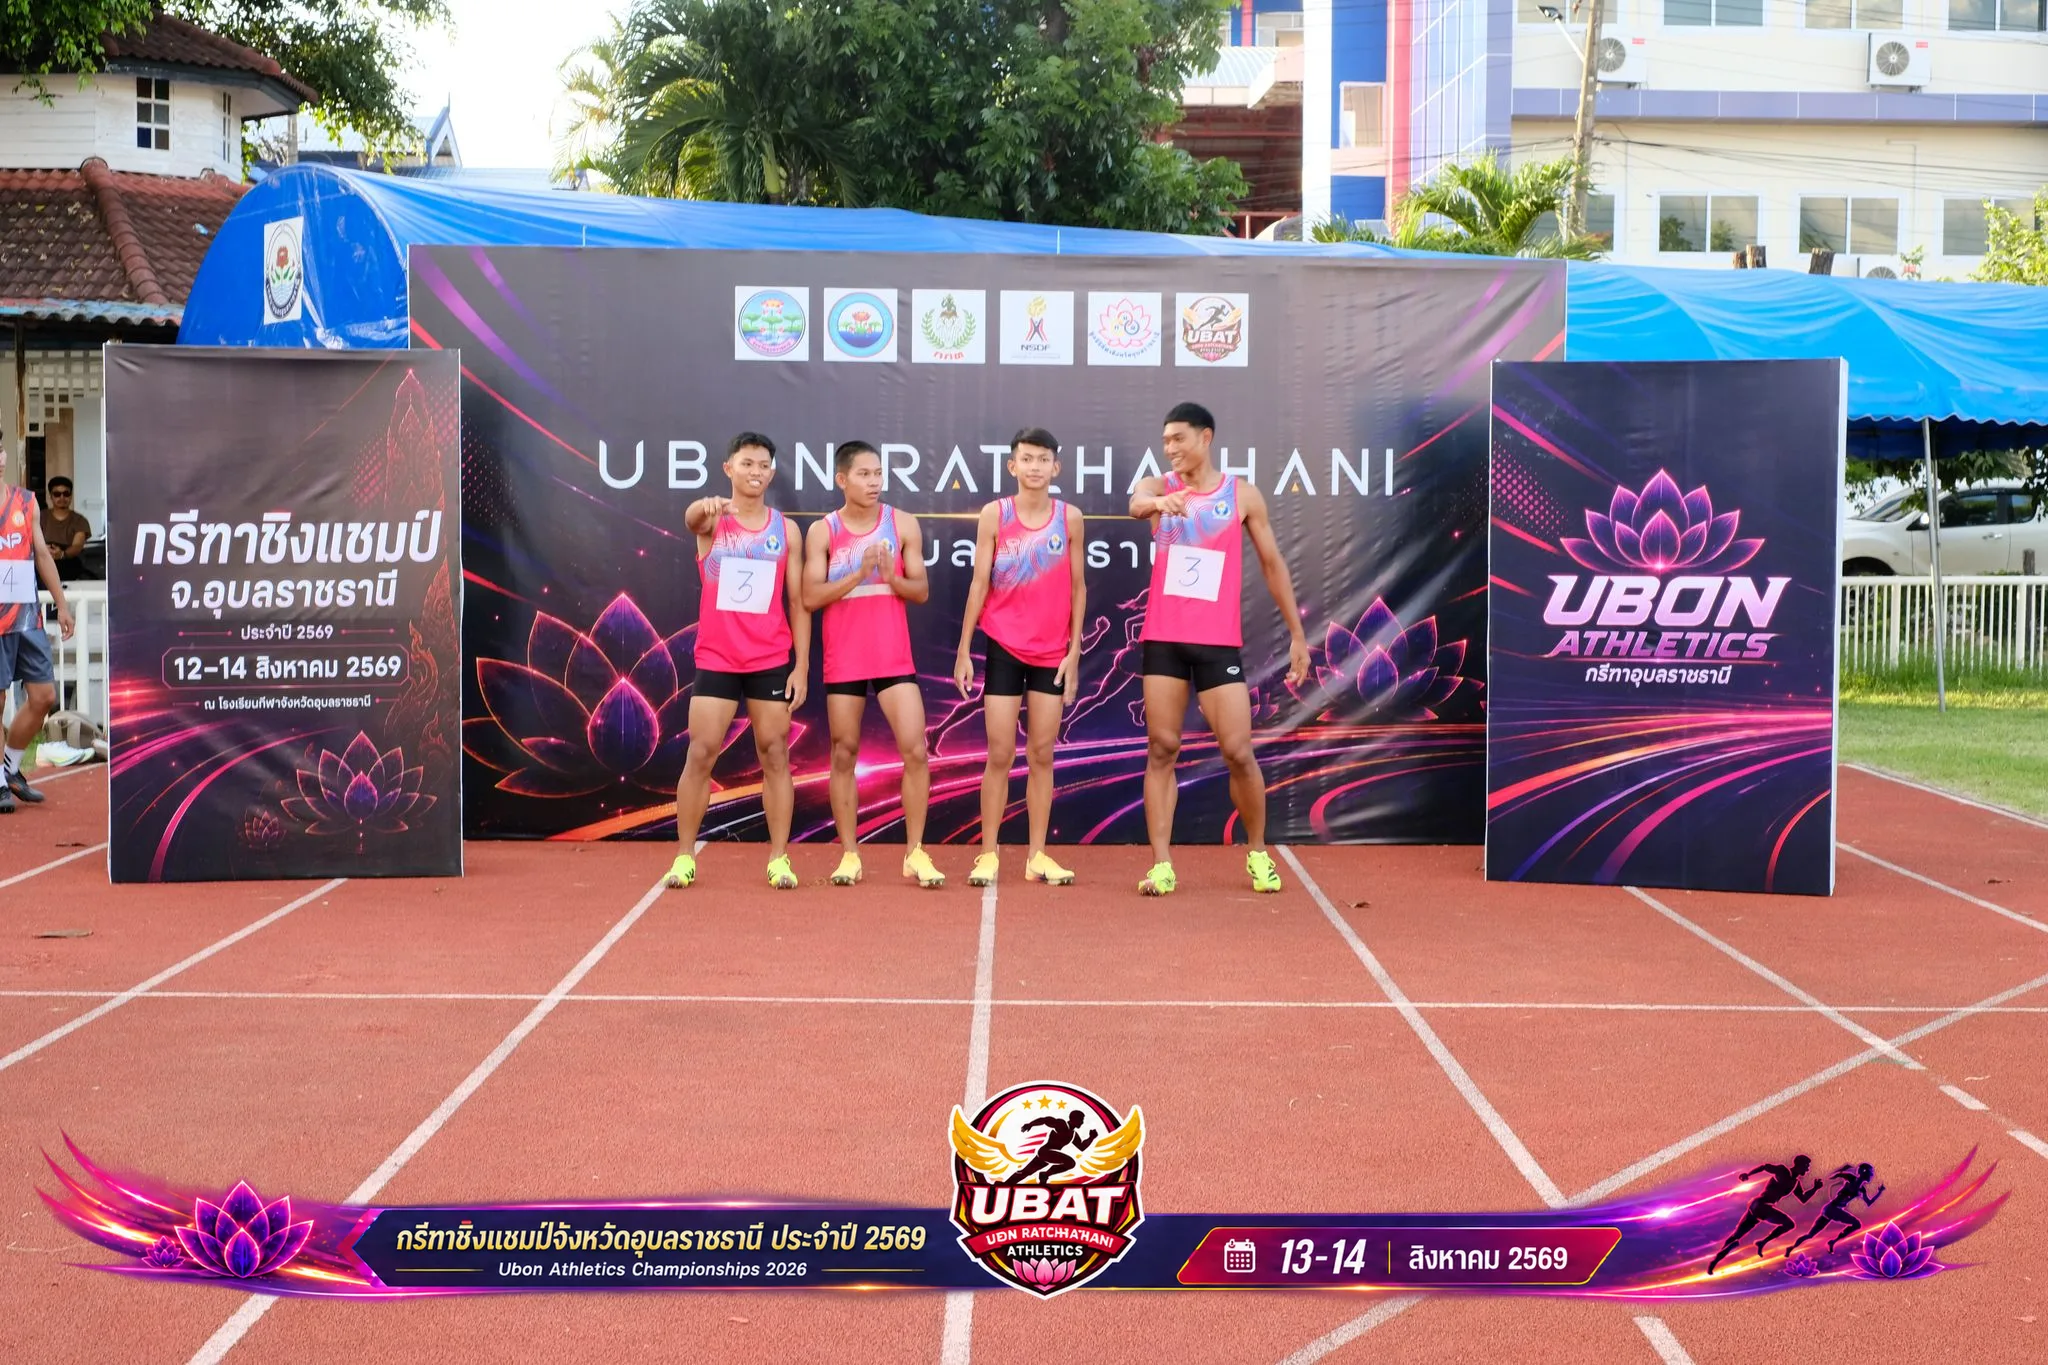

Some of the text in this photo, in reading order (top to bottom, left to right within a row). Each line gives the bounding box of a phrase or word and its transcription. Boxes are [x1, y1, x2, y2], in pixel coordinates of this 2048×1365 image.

[1186, 329, 1238, 345] UBAT
[598, 440, 1395, 498] UBN RATHAHANI
[132, 508, 443, 566] กรีฑาชิงแชมป์
[730, 570, 754, 604] 3
[1178, 555, 1202, 588] 3
[171, 569, 399, 620] จ.อุบลราชธานี
[1543, 574, 1793, 628] UBON
[240, 623, 334, 641] ประจำปี 2569
[1549, 630, 1778, 658] ATHLETICS
[255, 655, 338, 679] สิงหาคม
[346, 655, 401, 677] 2569
